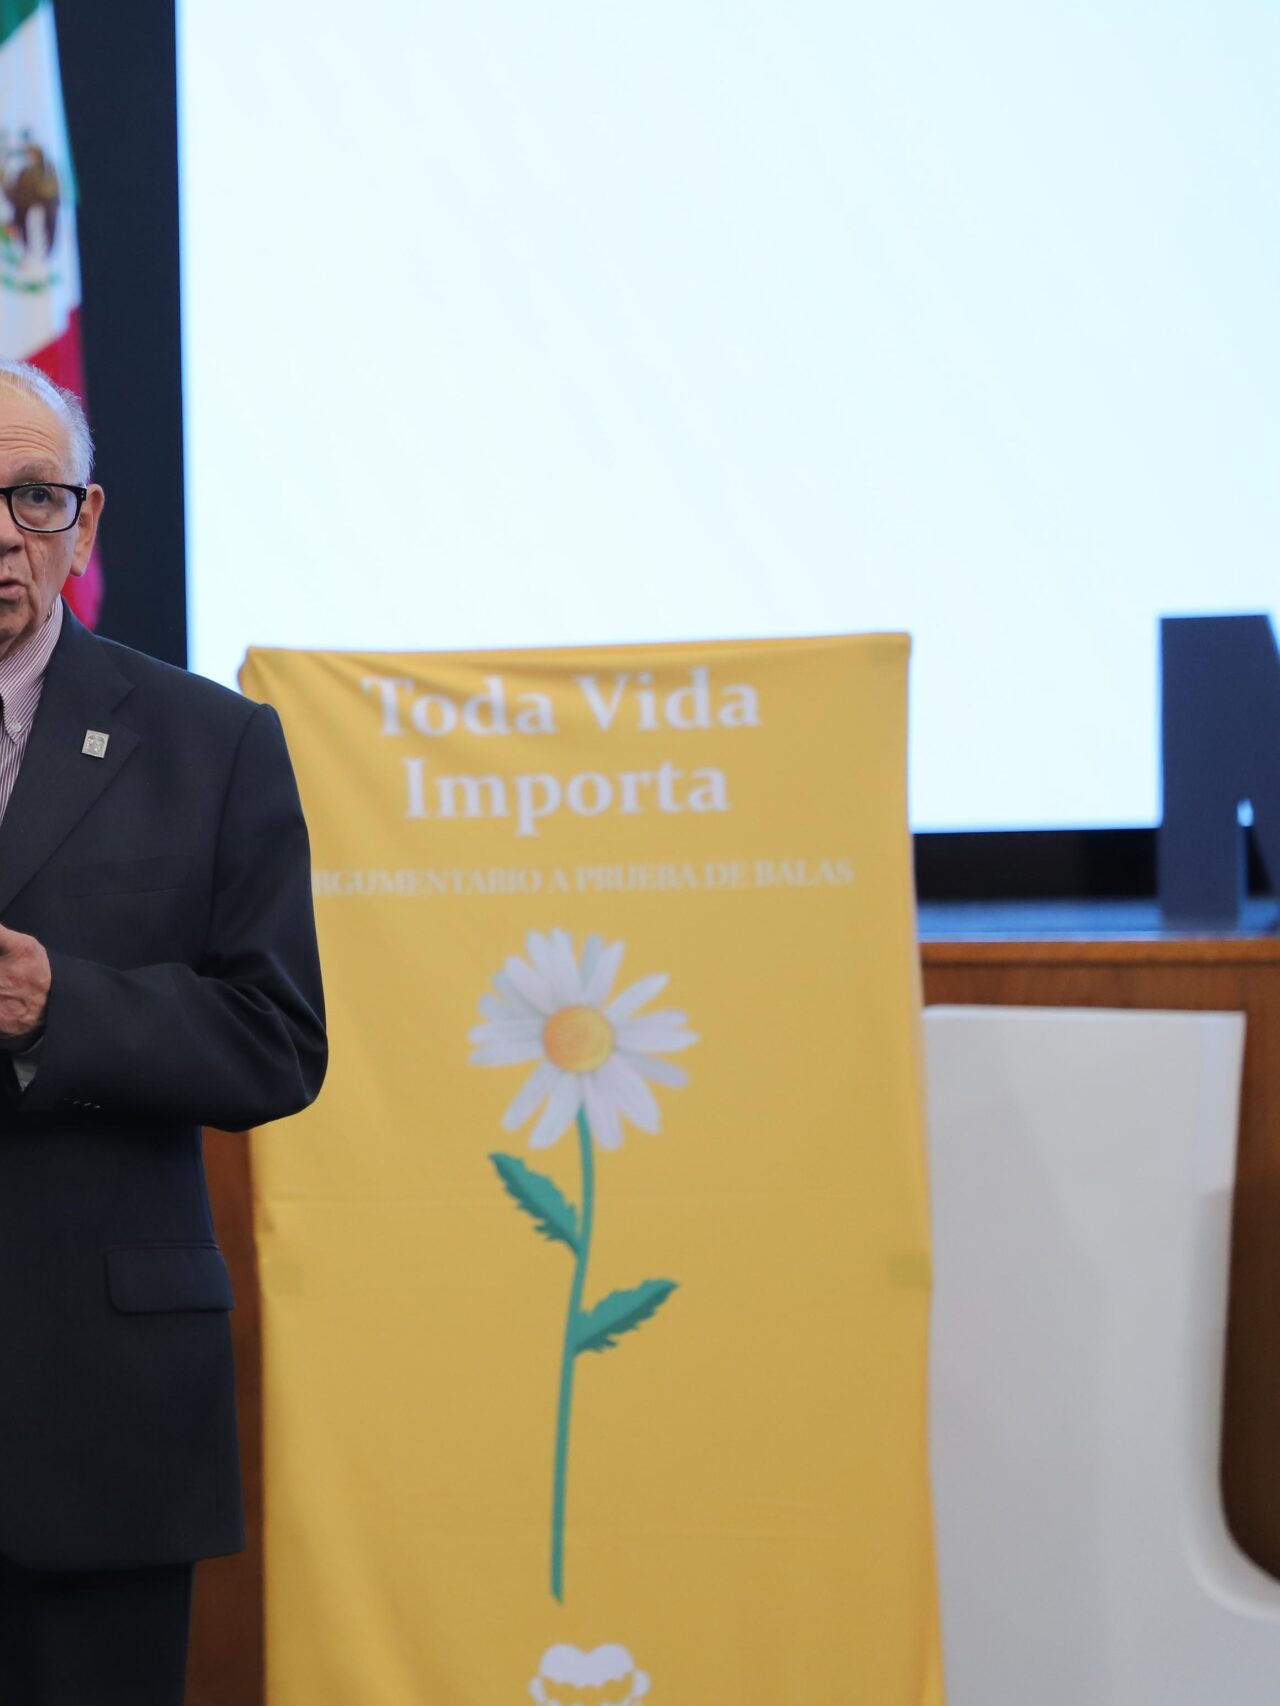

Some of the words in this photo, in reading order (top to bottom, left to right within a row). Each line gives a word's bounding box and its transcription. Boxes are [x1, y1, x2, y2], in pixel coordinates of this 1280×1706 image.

[361, 673, 557, 738] Toda
[573, 664, 763, 733] Vida
[402, 755, 732, 837] Importa
[311, 866, 543, 898] RGUMENTARIO
[547, 865, 570, 894] A
[574, 862, 699, 893] PRUEBA
[704, 861, 748, 890] DE
[754, 857, 855, 889] BALAS
